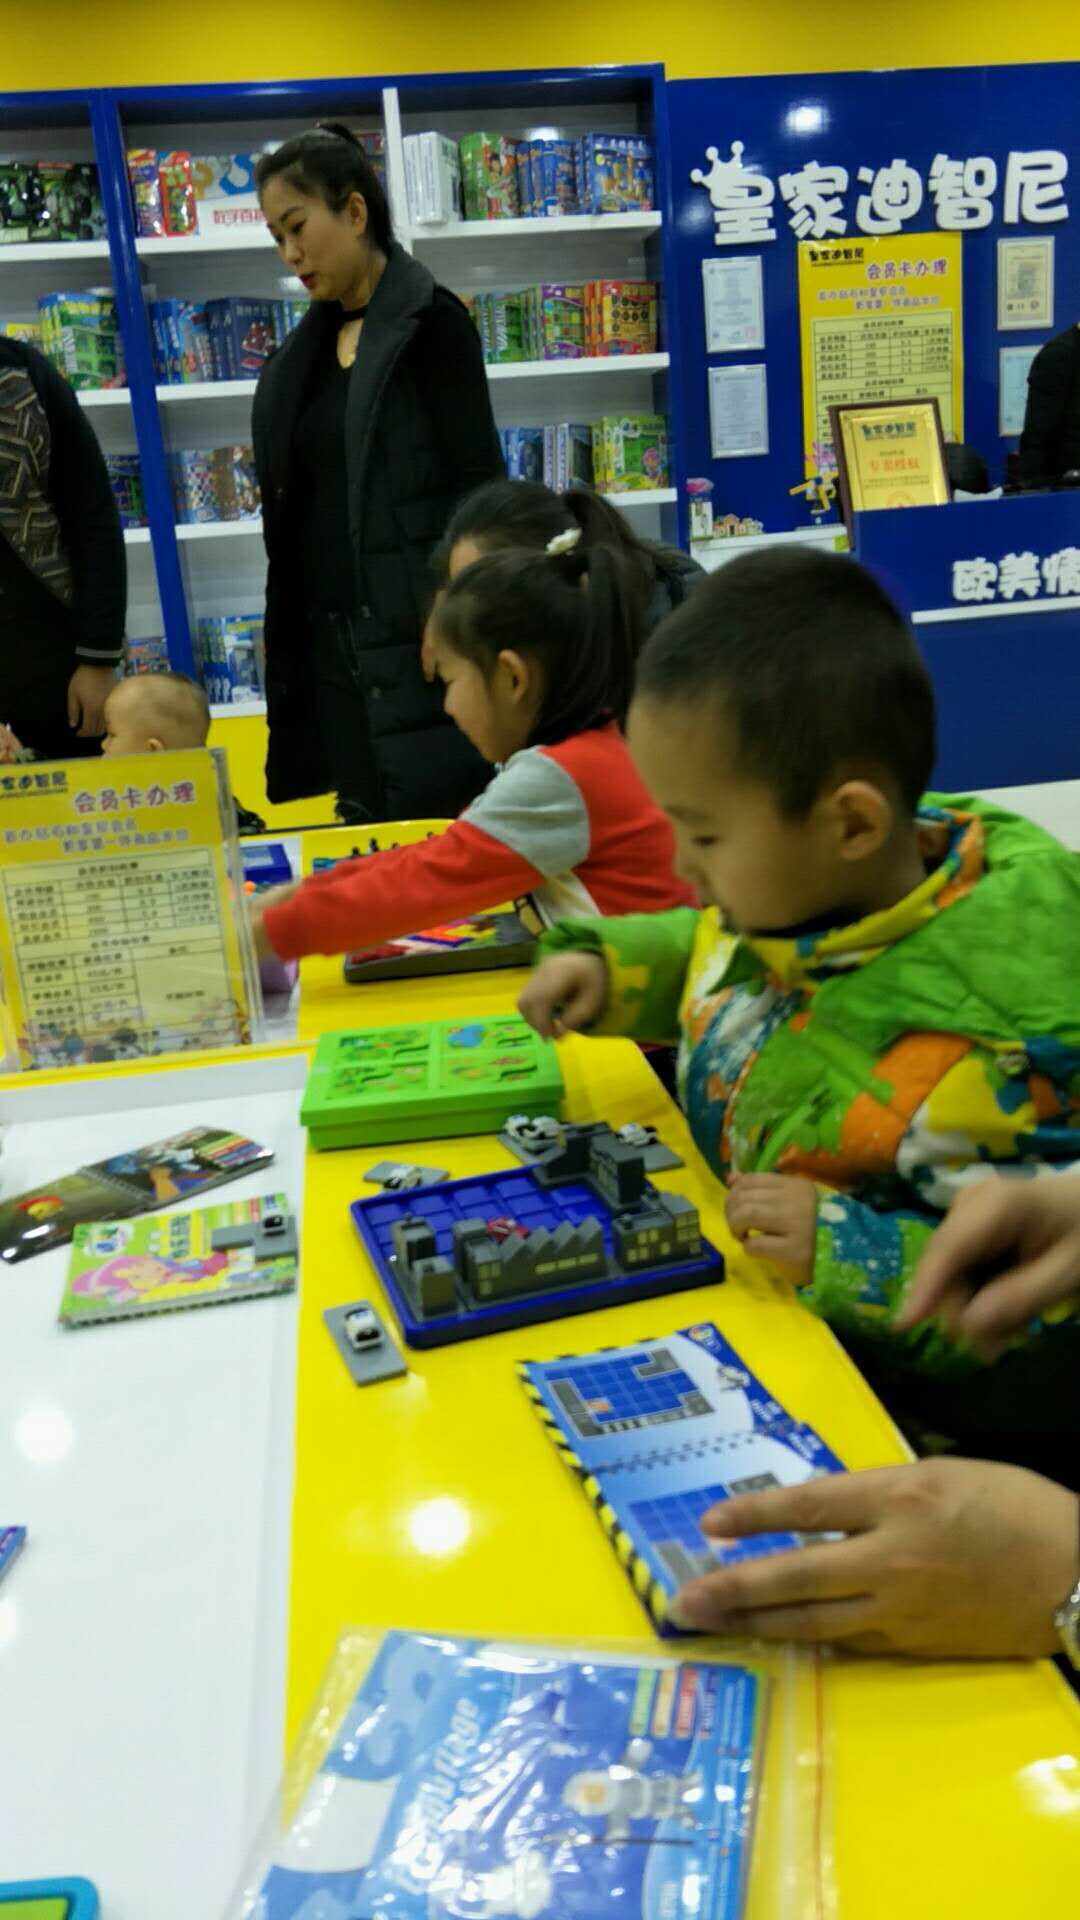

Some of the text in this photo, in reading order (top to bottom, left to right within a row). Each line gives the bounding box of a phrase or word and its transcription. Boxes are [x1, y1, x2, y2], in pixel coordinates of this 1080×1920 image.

[690, 141, 1070, 246] 皇家迪智尼
[866, 258, 949, 281] 会员卡办理
[953, 547, 1080, 601] 欧美情
[74, 782, 195, 813] 会员卡办理
